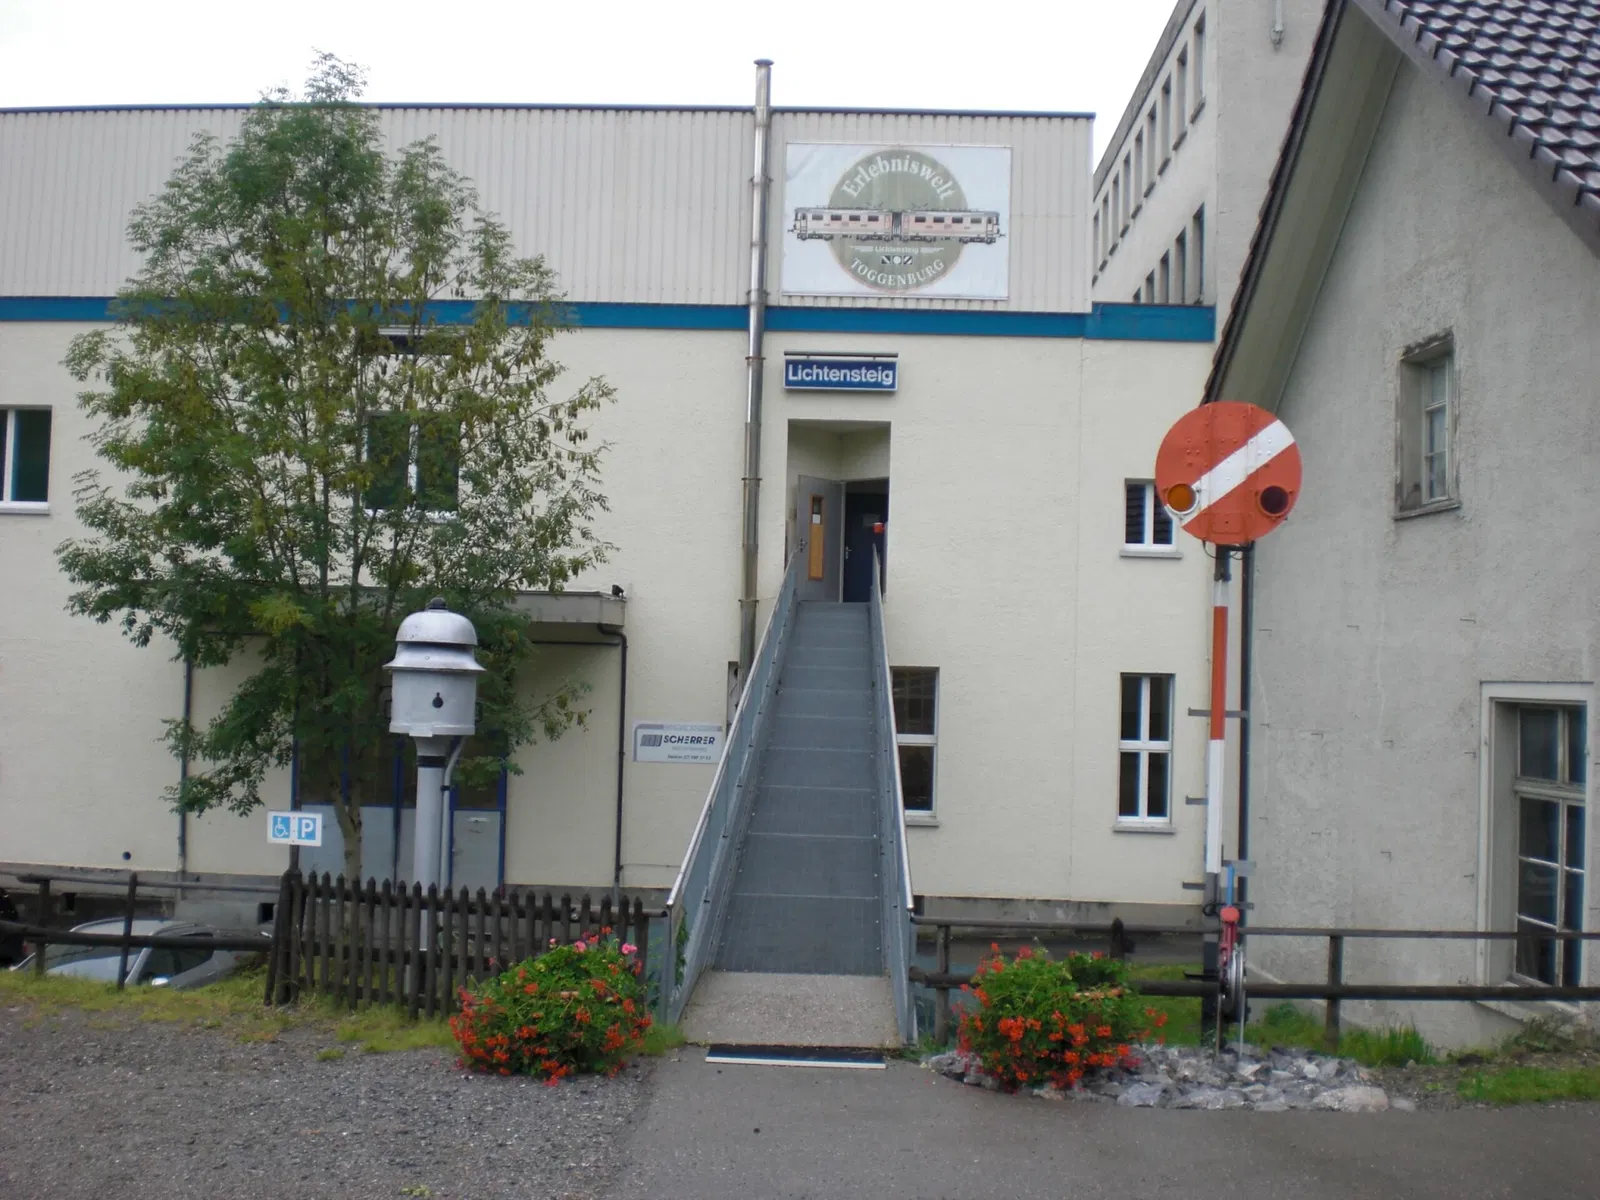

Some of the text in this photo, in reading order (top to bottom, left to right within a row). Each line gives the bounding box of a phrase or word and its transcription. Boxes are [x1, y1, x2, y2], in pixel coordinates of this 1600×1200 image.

[841, 154, 956, 201] Erlebniswelt
[850, 257, 945, 286] TOGGENBURG
[788, 363, 894, 386] Lichtensteig
[663, 735, 716, 745] SCHERRER
[301, 819, 314, 838] P
